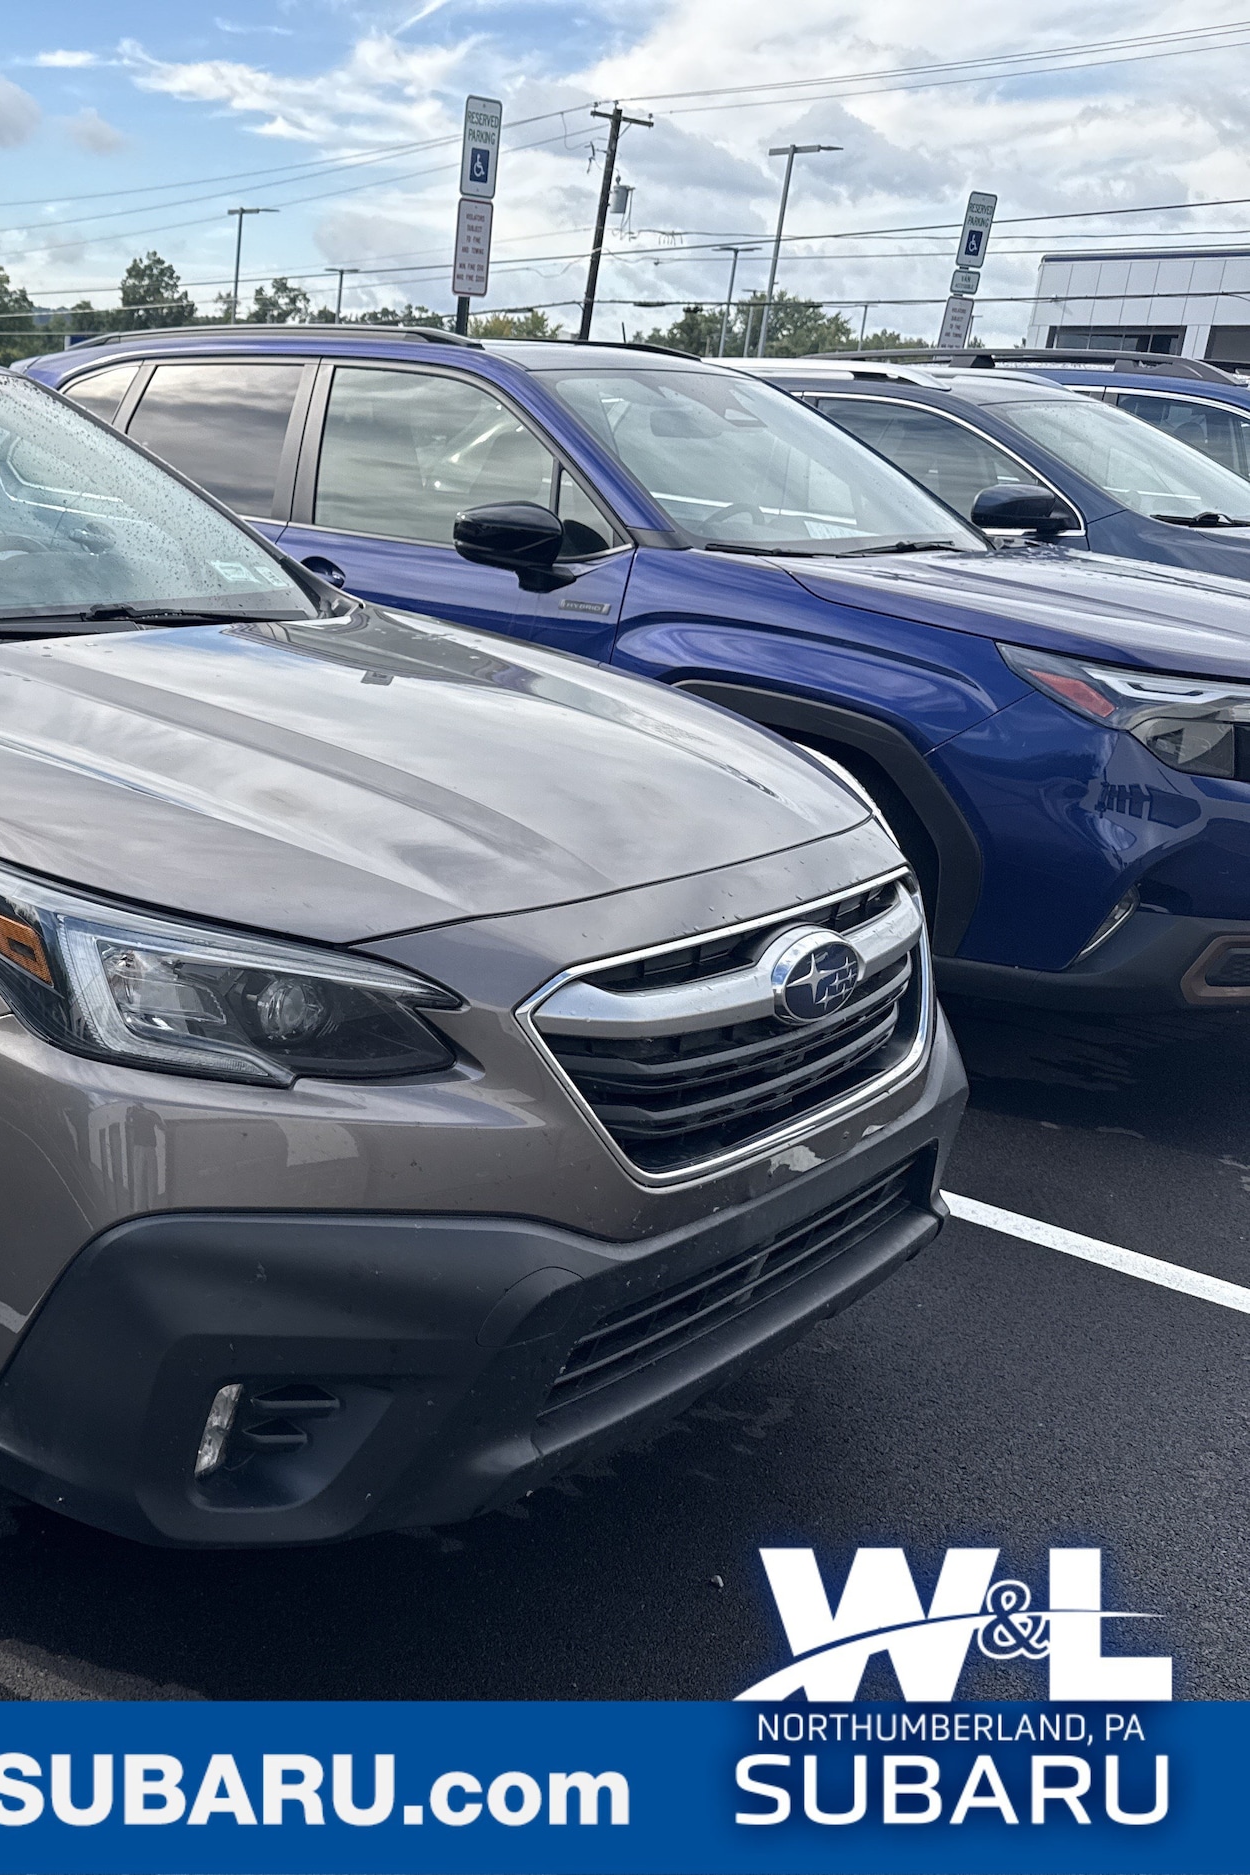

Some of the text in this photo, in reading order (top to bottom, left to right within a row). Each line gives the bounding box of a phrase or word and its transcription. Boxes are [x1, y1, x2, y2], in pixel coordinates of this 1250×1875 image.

[467, 111, 499, 128] RESERVED
[468, 129, 495, 145] PARKING
[969, 203, 993, 215] RESERVED
[968, 217, 990, 228] PARKING
[566, 602, 601, 612] HYBRID
